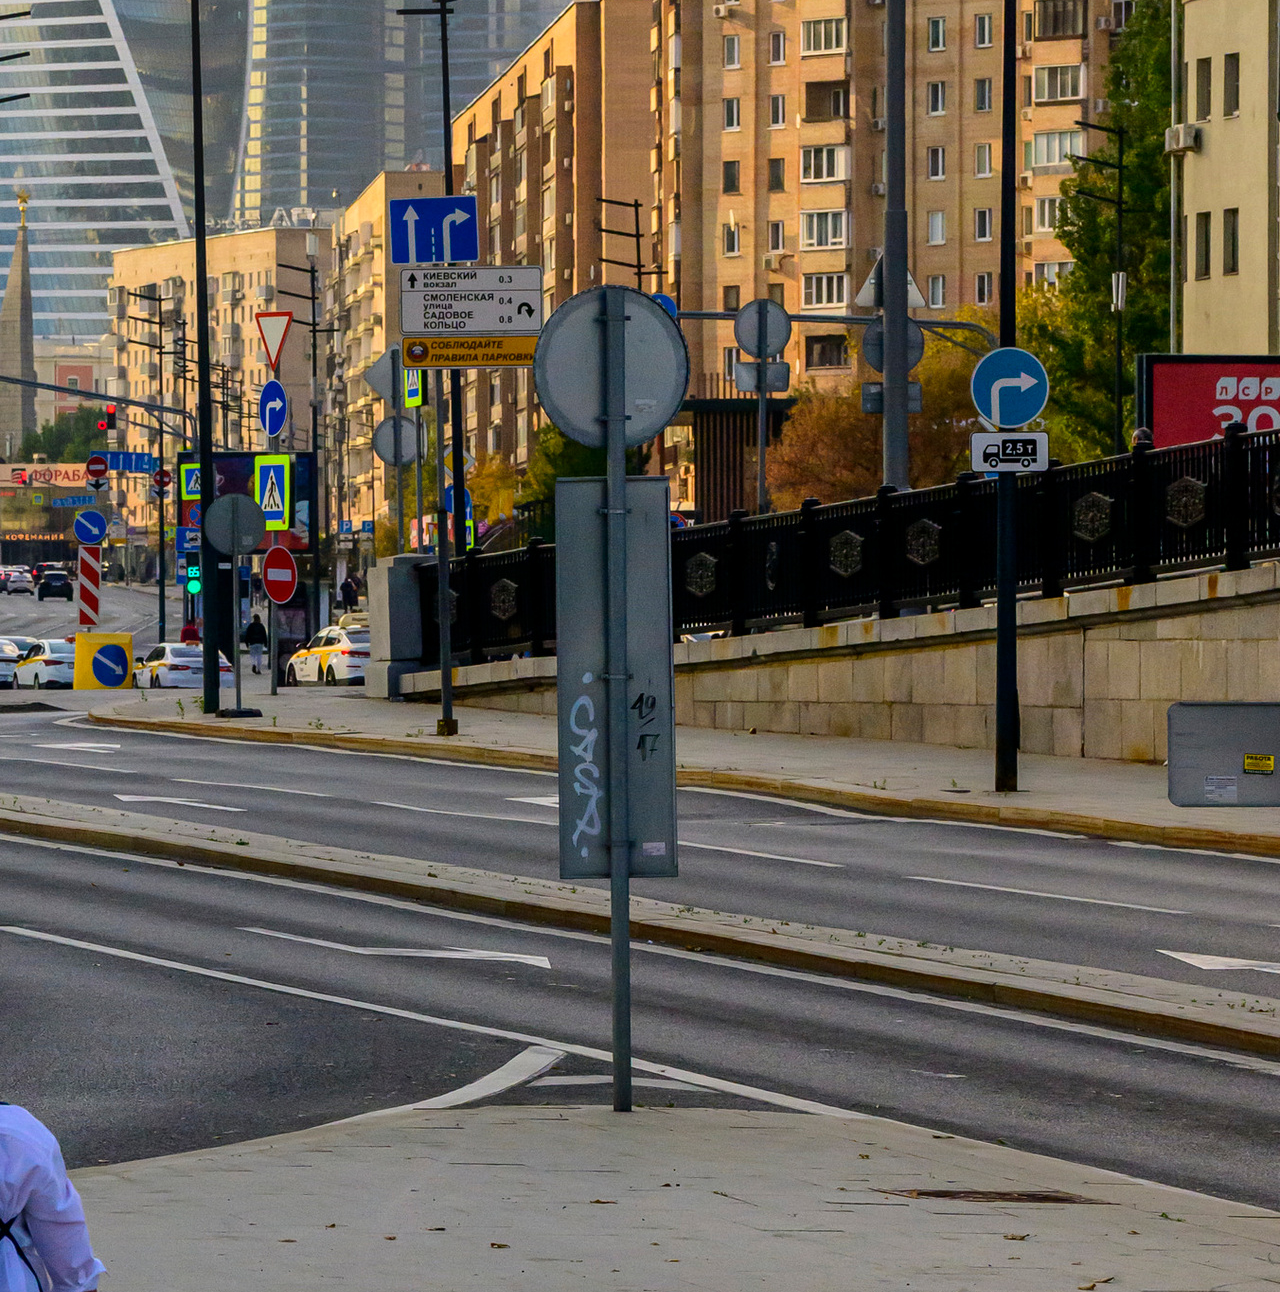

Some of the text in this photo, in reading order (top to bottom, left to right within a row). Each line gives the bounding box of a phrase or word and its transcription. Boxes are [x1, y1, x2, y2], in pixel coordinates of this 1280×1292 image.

[423, 271, 477, 280] КИЕВСКИЙ
[499, 275, 513, 284] 0.3
[423, 293, 494, 302] СМОЛЕНСКАЯ
[499, 297, 513, 305] 0.4
[423, 303, 453, 311] улица
[423, 311, 474, 320] САДОВОЕ
[499, 316, 513, 324] 0.8
[423, 321, 466, 330] КОЛЬЦО
[431, 340, 504, 350] СОБЛЮДАЙТЕ
[430, 353, 479, 362] ПРАВИЛА
[1005, 442, 1023, 455] 2,5
[32, 469, 88, 482] ФОРАБА
[5, 533, 64, 541] КОФЕМАНИЯ
